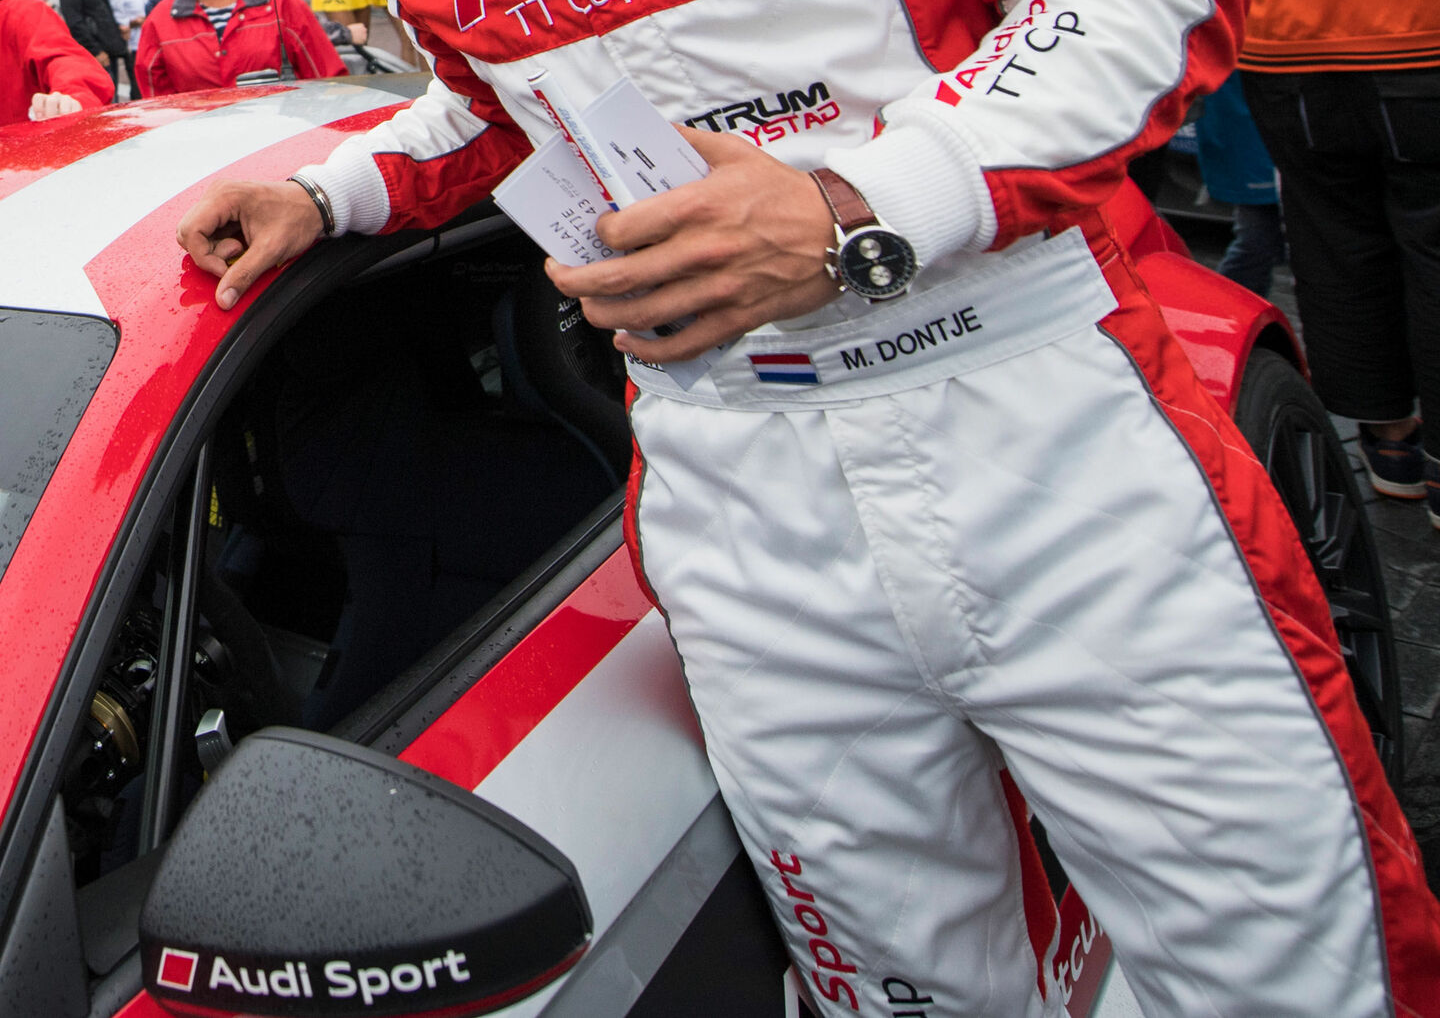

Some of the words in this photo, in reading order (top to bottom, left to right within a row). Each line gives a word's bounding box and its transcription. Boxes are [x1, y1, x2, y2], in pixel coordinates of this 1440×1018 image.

[986, 54, 1036, 97] TT
[578, 198, 597, 214] 43
[550, 221, 595, 264] MILAN
[561, 208, 614, 258] DONTJE
[840, 347, 874, 370] M.
[876, 306, 982, 362] DONTJE
[770, 850, 859, 1011] Sport
[210, 956, 313, 998] Audi
[324, 949, 471, 1005] Sport
